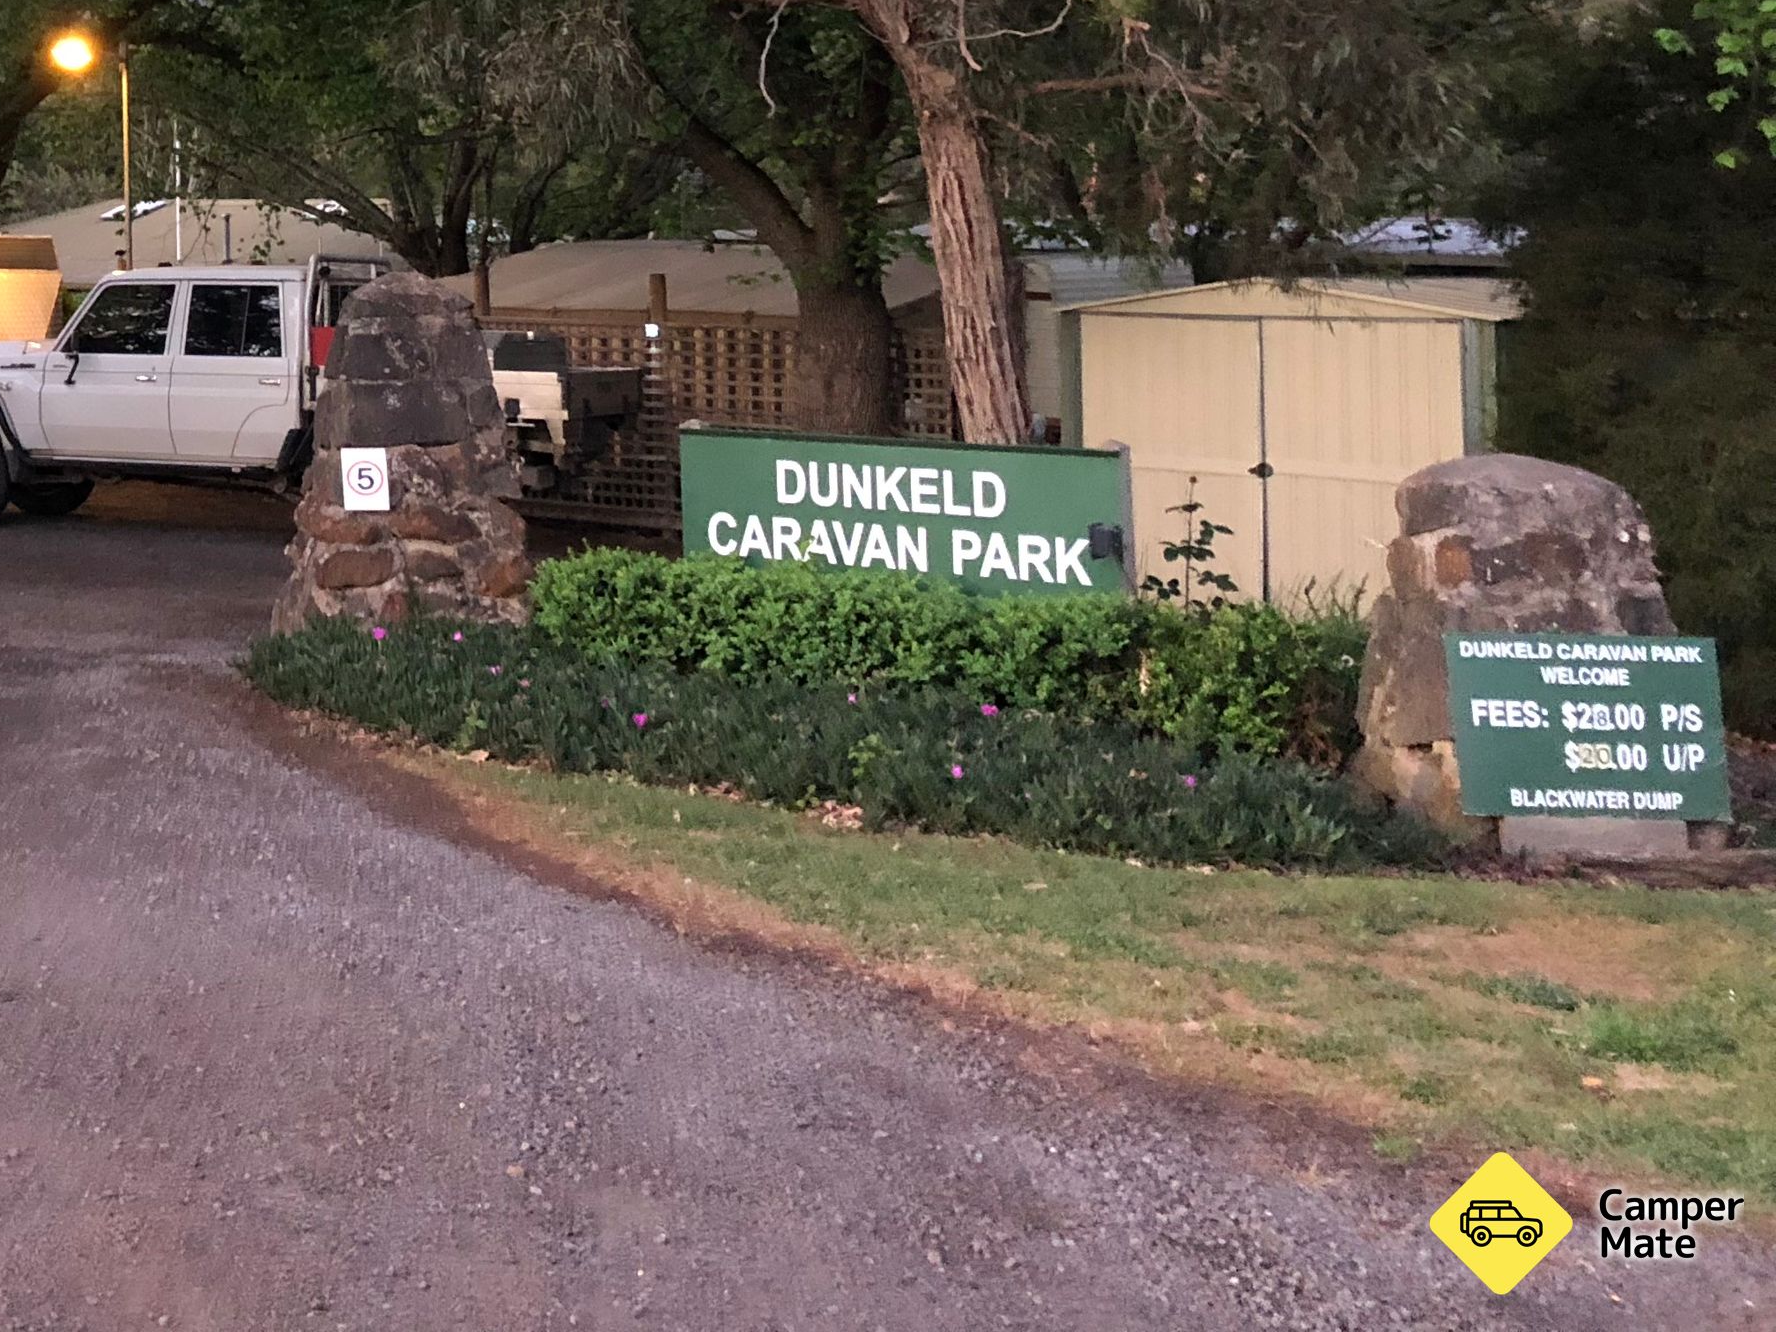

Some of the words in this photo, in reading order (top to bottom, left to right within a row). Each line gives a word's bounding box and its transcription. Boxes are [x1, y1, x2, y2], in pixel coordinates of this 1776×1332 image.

[357, 468, 374, 490] 5
[775, 459, 1006, 518] DUNKELD
[707, 511, 928, 573] CARAVAN
[951, 529, 1093, 587] PARK
[1458, 639, 1553, 660] DUNKELD
[1556, 642, 1648, 662] CARAVAN
[1650, 644, 1704, 664] PARK
[1539, 665, 1631, 687] WELCOME
[1470, 697, 1550, 729] FEES:
[1659, 702, 1704, 733] P/S
[1662, 742, 1706, 773] U/P
[1509, 787, 1631, 810] BLACKWATER
[1633, 790, 1684, 811] DUMP
